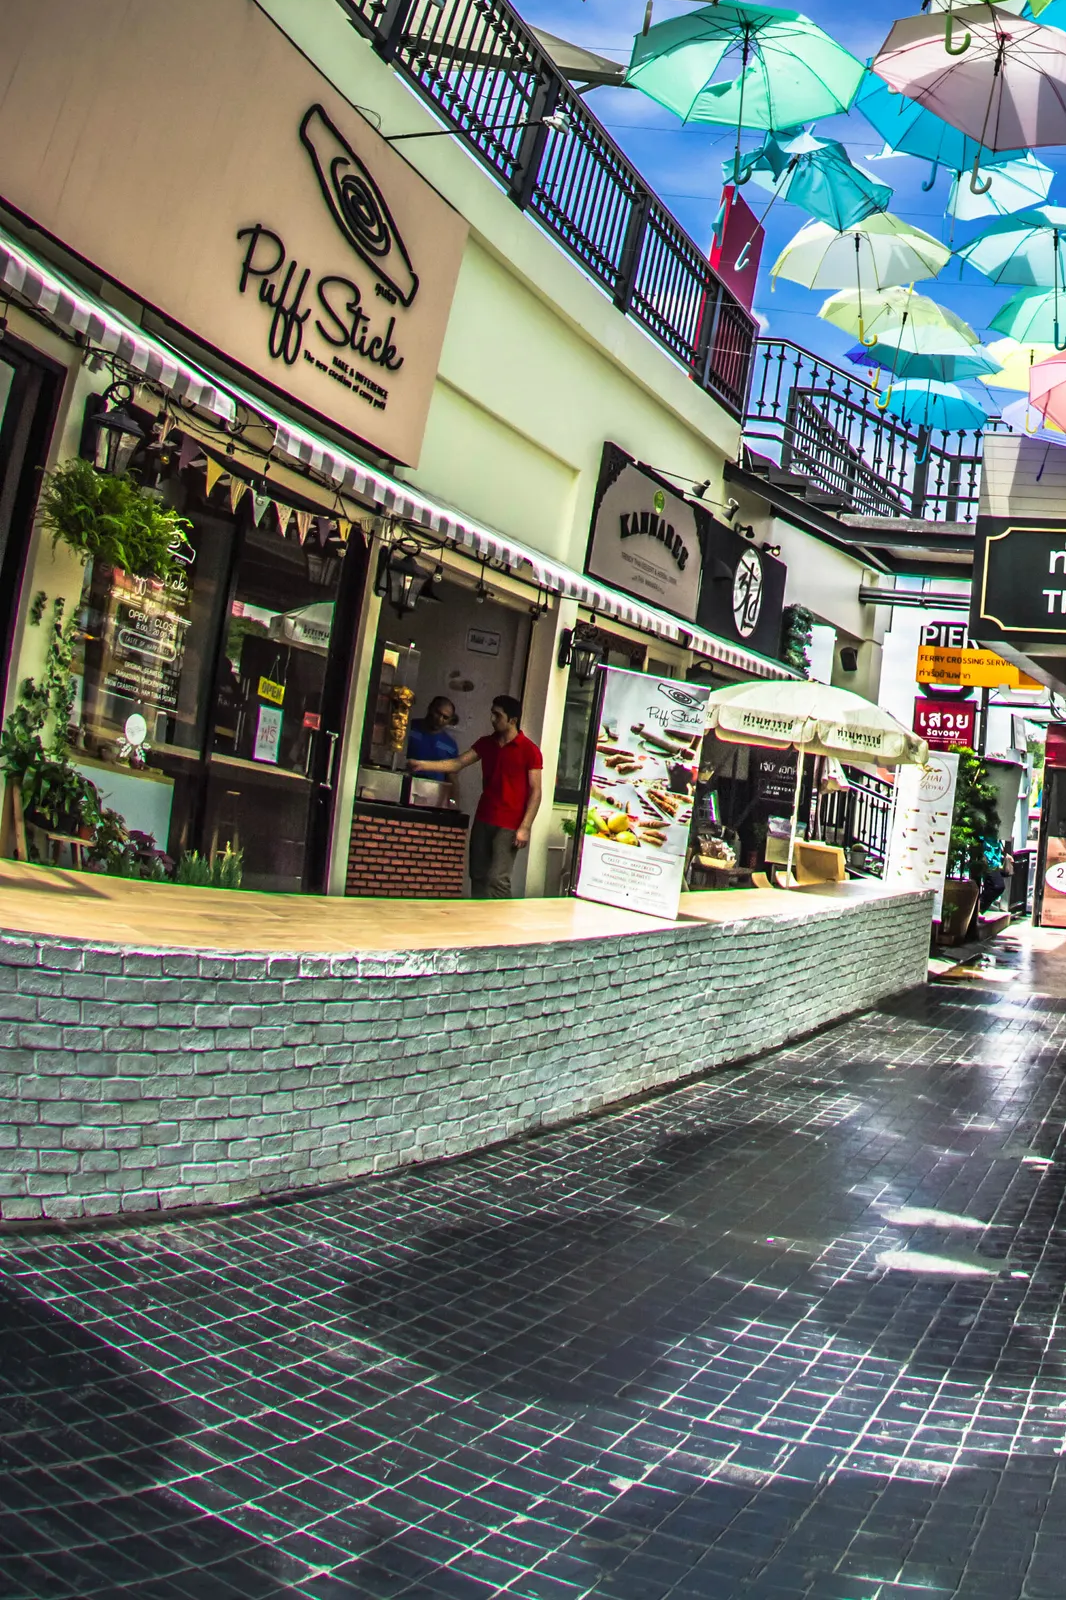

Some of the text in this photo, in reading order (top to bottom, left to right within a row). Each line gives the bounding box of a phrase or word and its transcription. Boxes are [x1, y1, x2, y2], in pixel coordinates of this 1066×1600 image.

[236, 223, 405, 371] Puff Stick
[128, 609, 149, 623] OPEN
[920, 654, 945, 663] FERRY
[946, 656, 985, 666] CROSSING
[261, 681, 282, 700] OPEN
[646, 706, 670, 728] Puff
[671, 709, 704, 725] Stick
[920, 711, 970, 730] เสวย
[926, 728, 960, 740] Savoey
